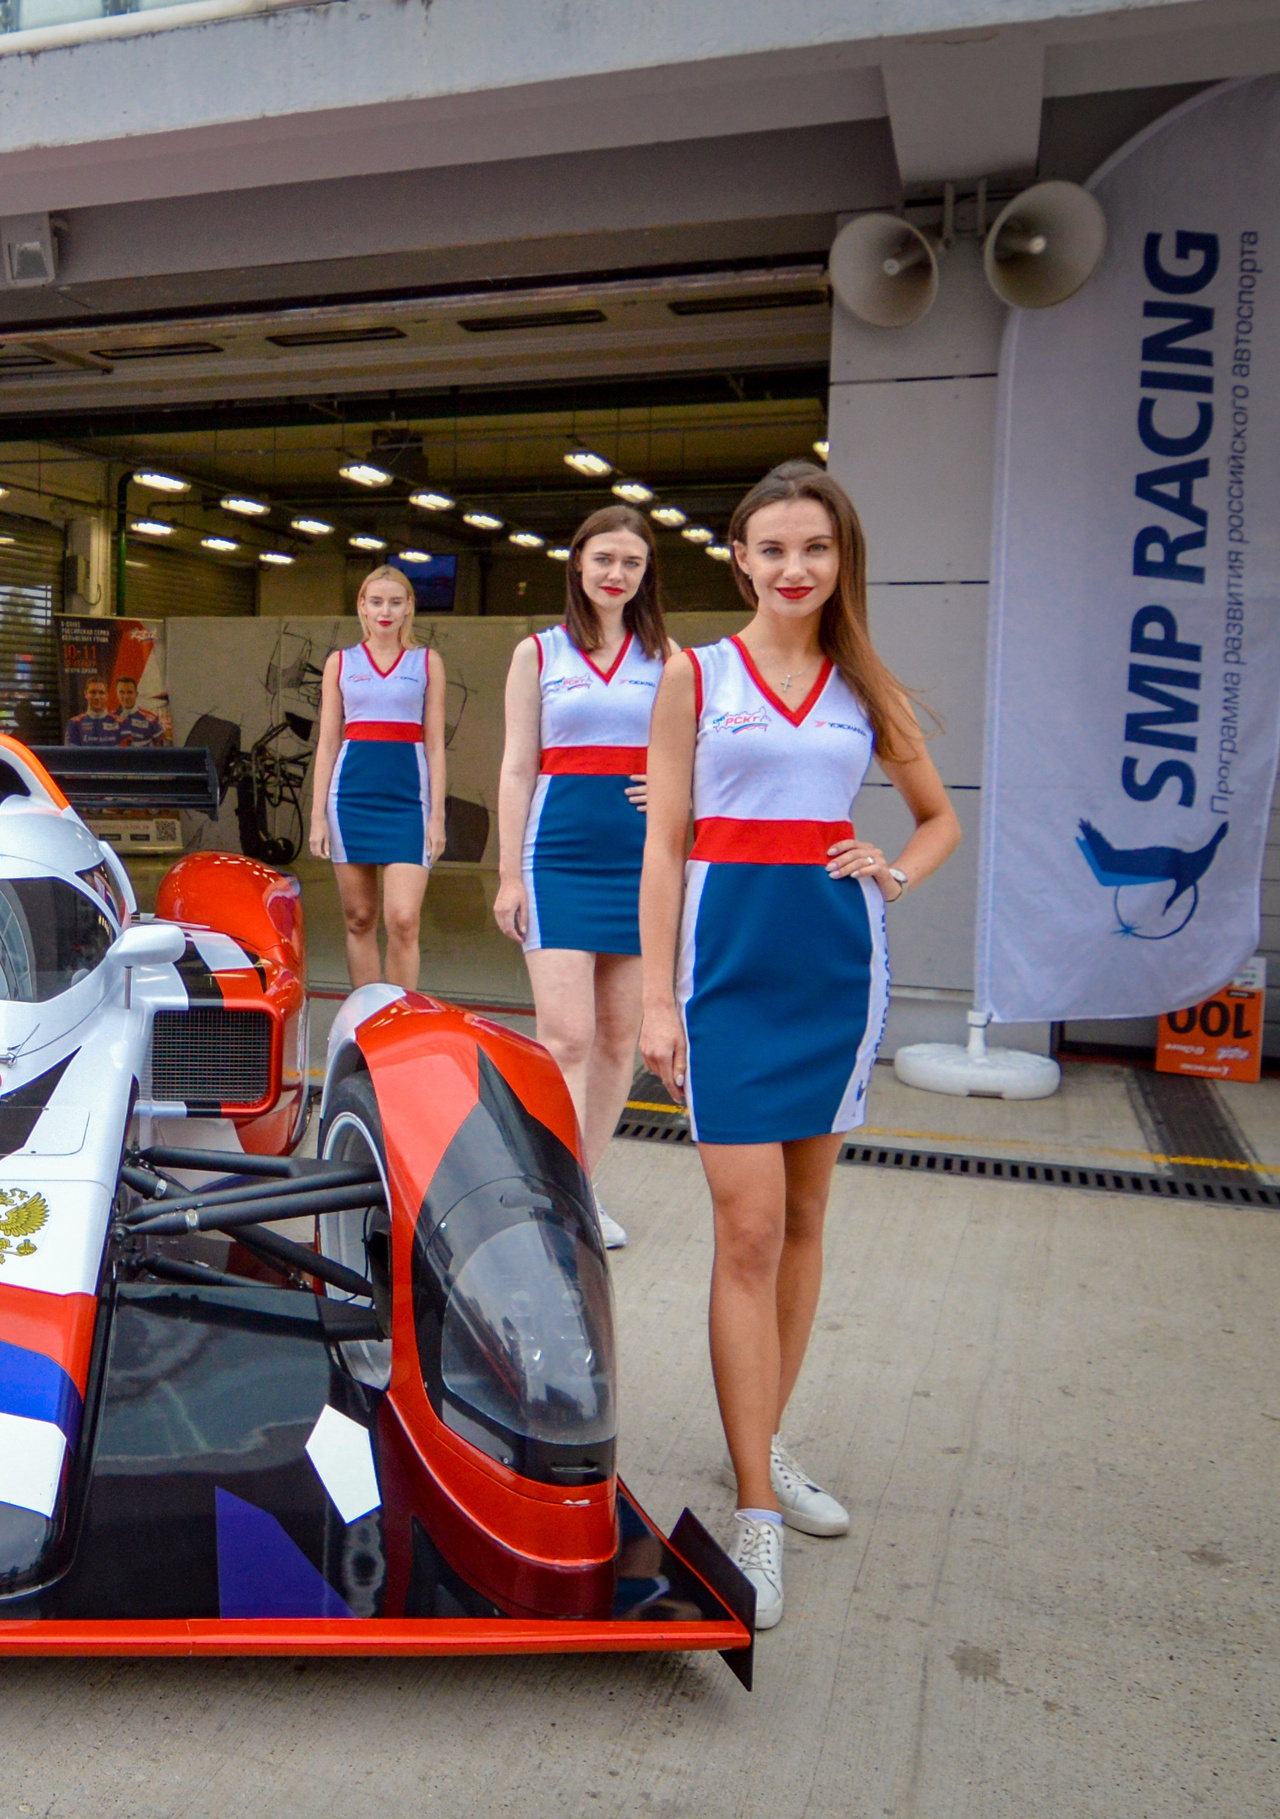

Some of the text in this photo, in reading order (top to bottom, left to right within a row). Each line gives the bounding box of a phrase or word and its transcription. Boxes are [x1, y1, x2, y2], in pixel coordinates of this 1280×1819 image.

[62, 644, 97, 660] 10-11
[1121, 229, 1220, 809] SMP RACING
[1210, 230, 1264, 815] Программа развития российского автоспорта
[1166, 1000, 1253, 1039] 100
